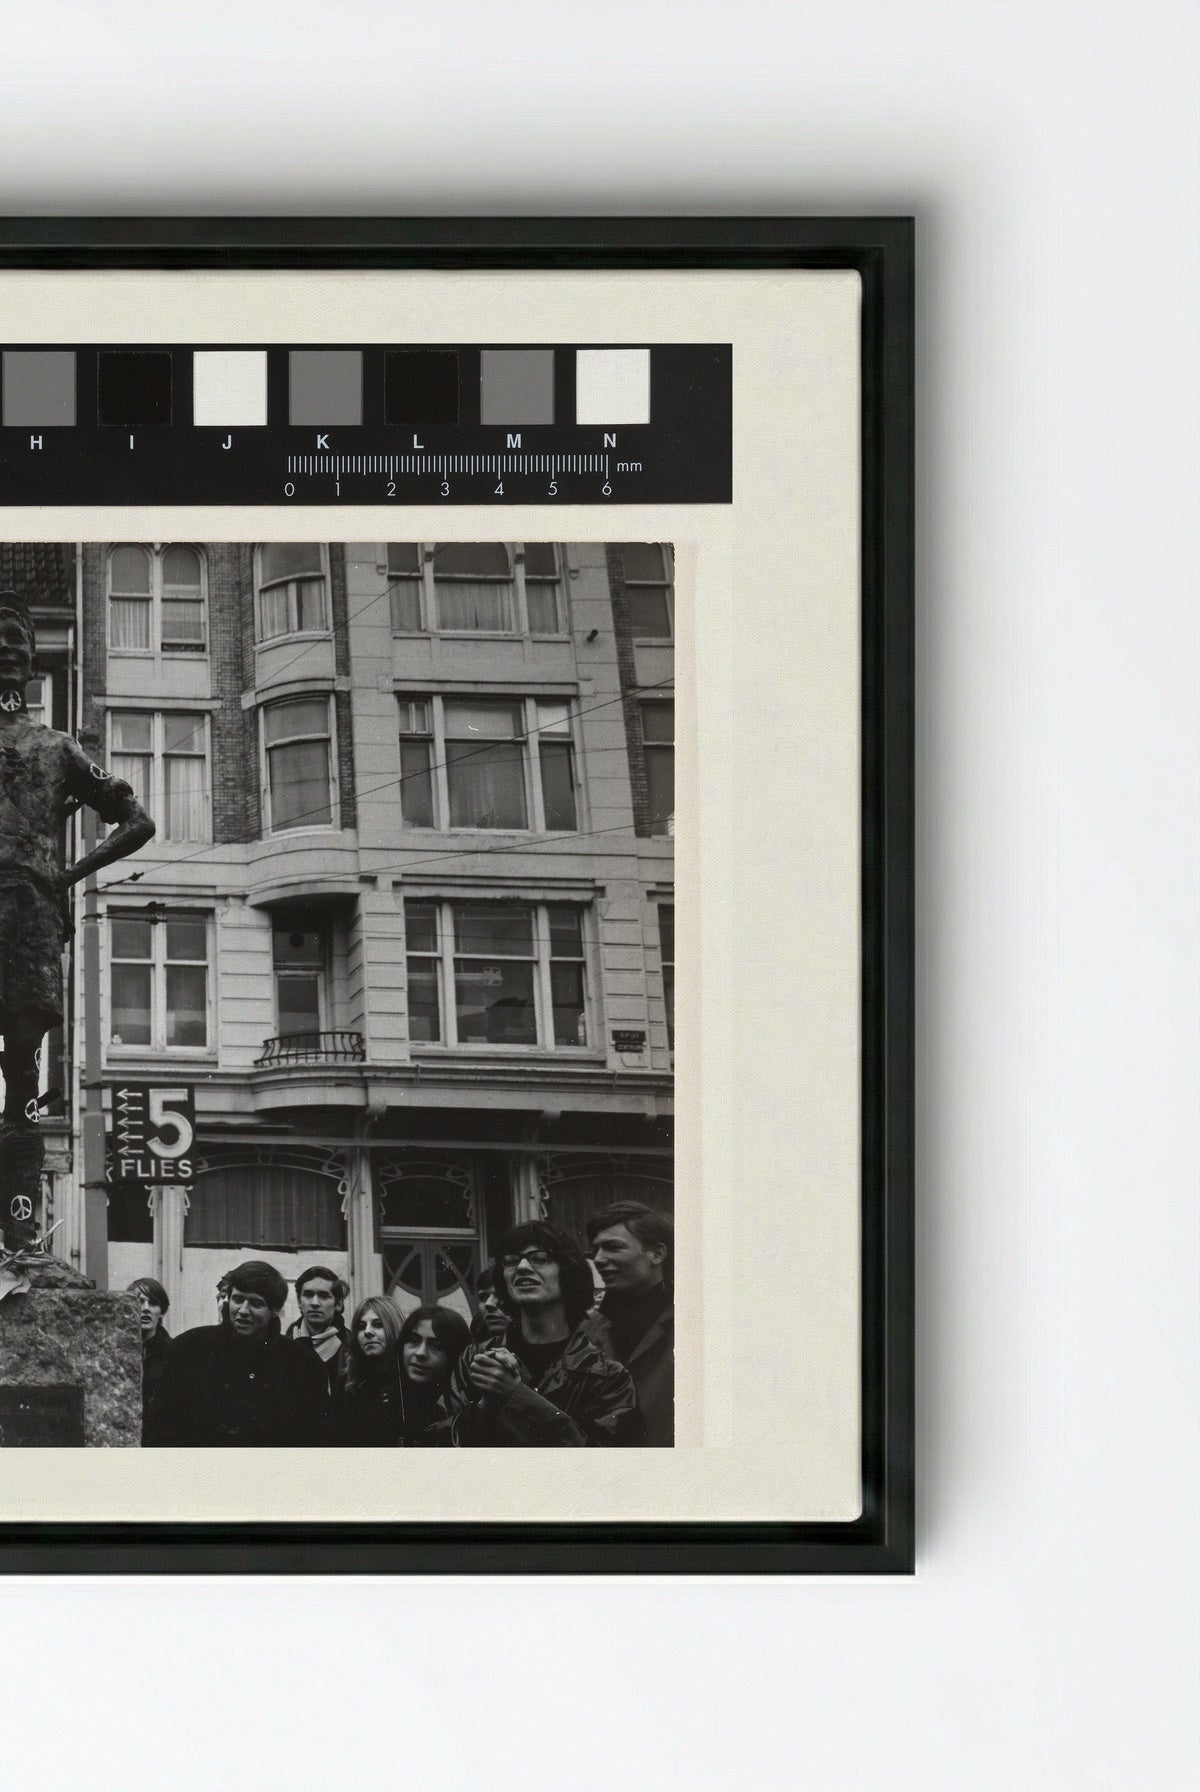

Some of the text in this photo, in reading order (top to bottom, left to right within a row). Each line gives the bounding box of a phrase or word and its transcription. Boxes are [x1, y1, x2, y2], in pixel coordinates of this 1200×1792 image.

[30, 435, 43, 450] H
[221, 434, 232, 450] J
[316, 434, 330, 450] K
[413, 434, 425, 449] L
[506, 434, 522, 449] M
[603, 433, 617, 448] N
[616, 462, 642, 472] mm
[284, 482, 295, 497] 0
[386, 482, 396, 497] 2
[440, 481, 450, 497] 3
[493, 481, 505, 496] 4
[547, 481, 558, 496] 5
[601, 481, 612, 496] 6
[146, 1087, 193, 1159] 5
[120, 1158, 193, 1178] FLIES
